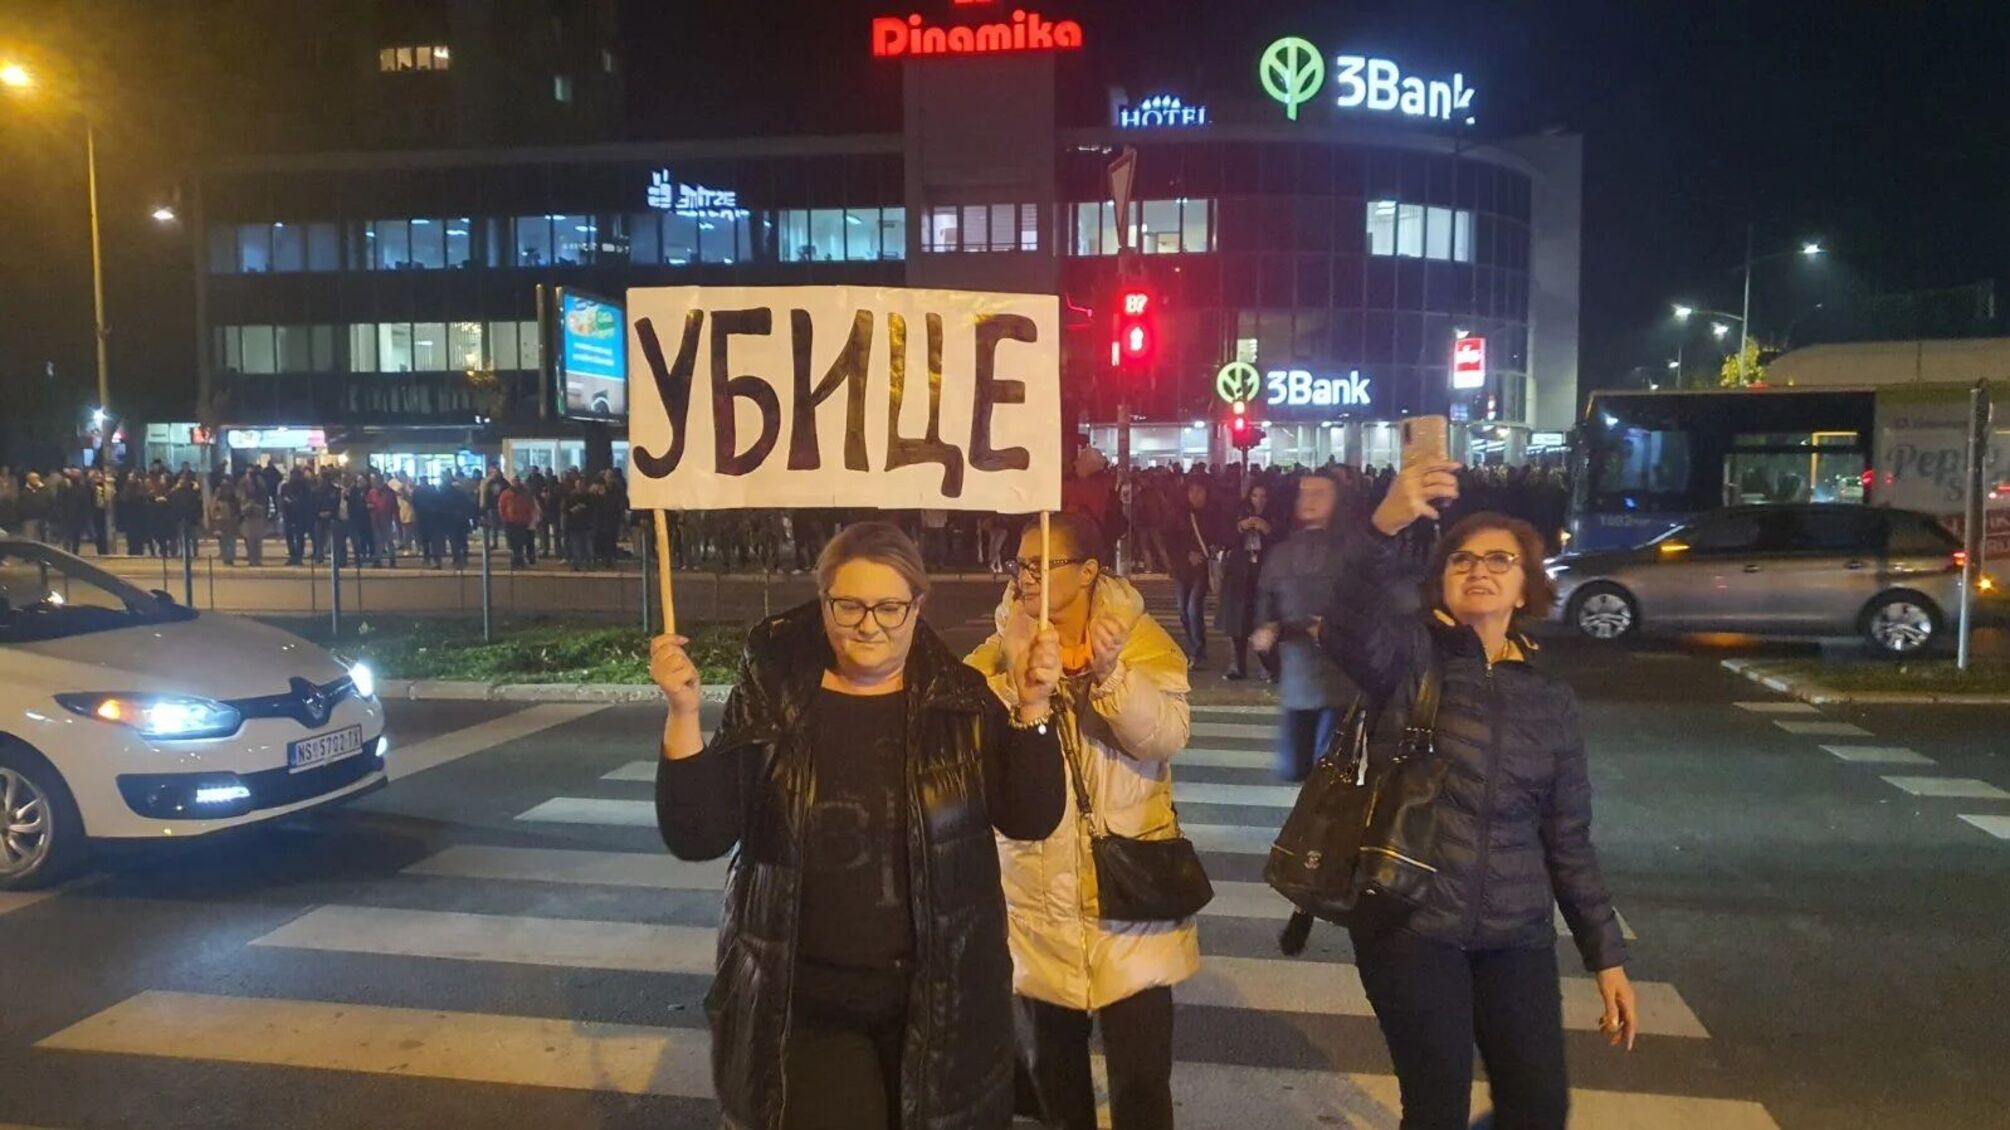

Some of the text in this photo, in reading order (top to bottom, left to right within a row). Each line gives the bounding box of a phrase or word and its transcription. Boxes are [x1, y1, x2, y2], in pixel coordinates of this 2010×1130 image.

[872, 9, 1083, 56] Dinamika
[1336, 55, 1476, 125] 3Bank
[632, 307, 1038, 499] УБИЦЕ
[1266, 370, 1371, 405] 3Bank
[297, 741, 312, 763] NS
